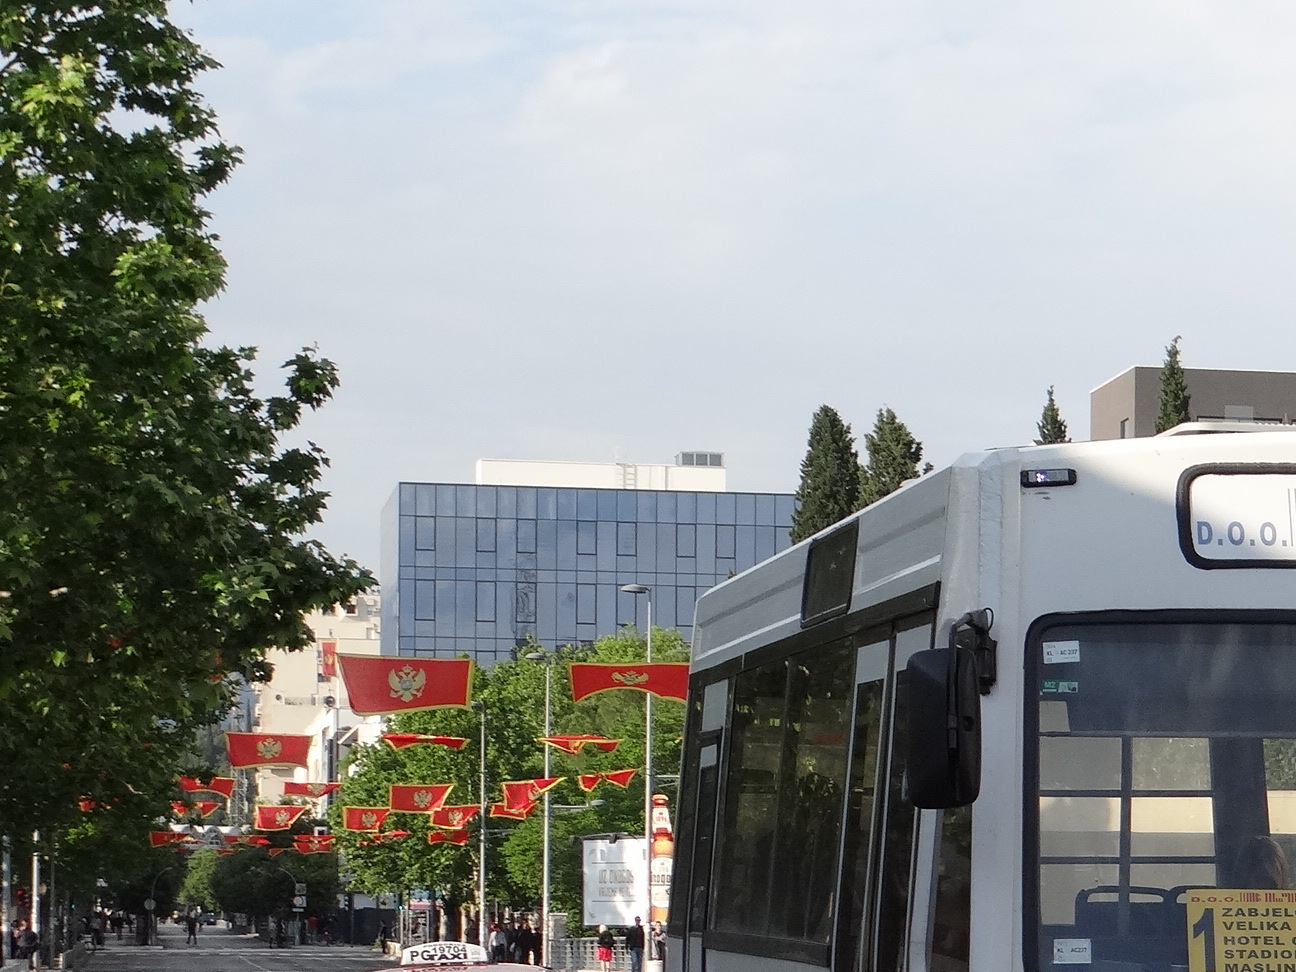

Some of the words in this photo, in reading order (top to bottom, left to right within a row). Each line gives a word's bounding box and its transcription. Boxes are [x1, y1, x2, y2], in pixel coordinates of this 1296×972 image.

[1222, 921, 1292, 931] VELIKA
[1192, 907, 1217, 972] 1
[1223, 935, 1286, 946] HOTEL
[432, 945, 467, 953] 19704
[427, 953, 468, 961] TAXI
